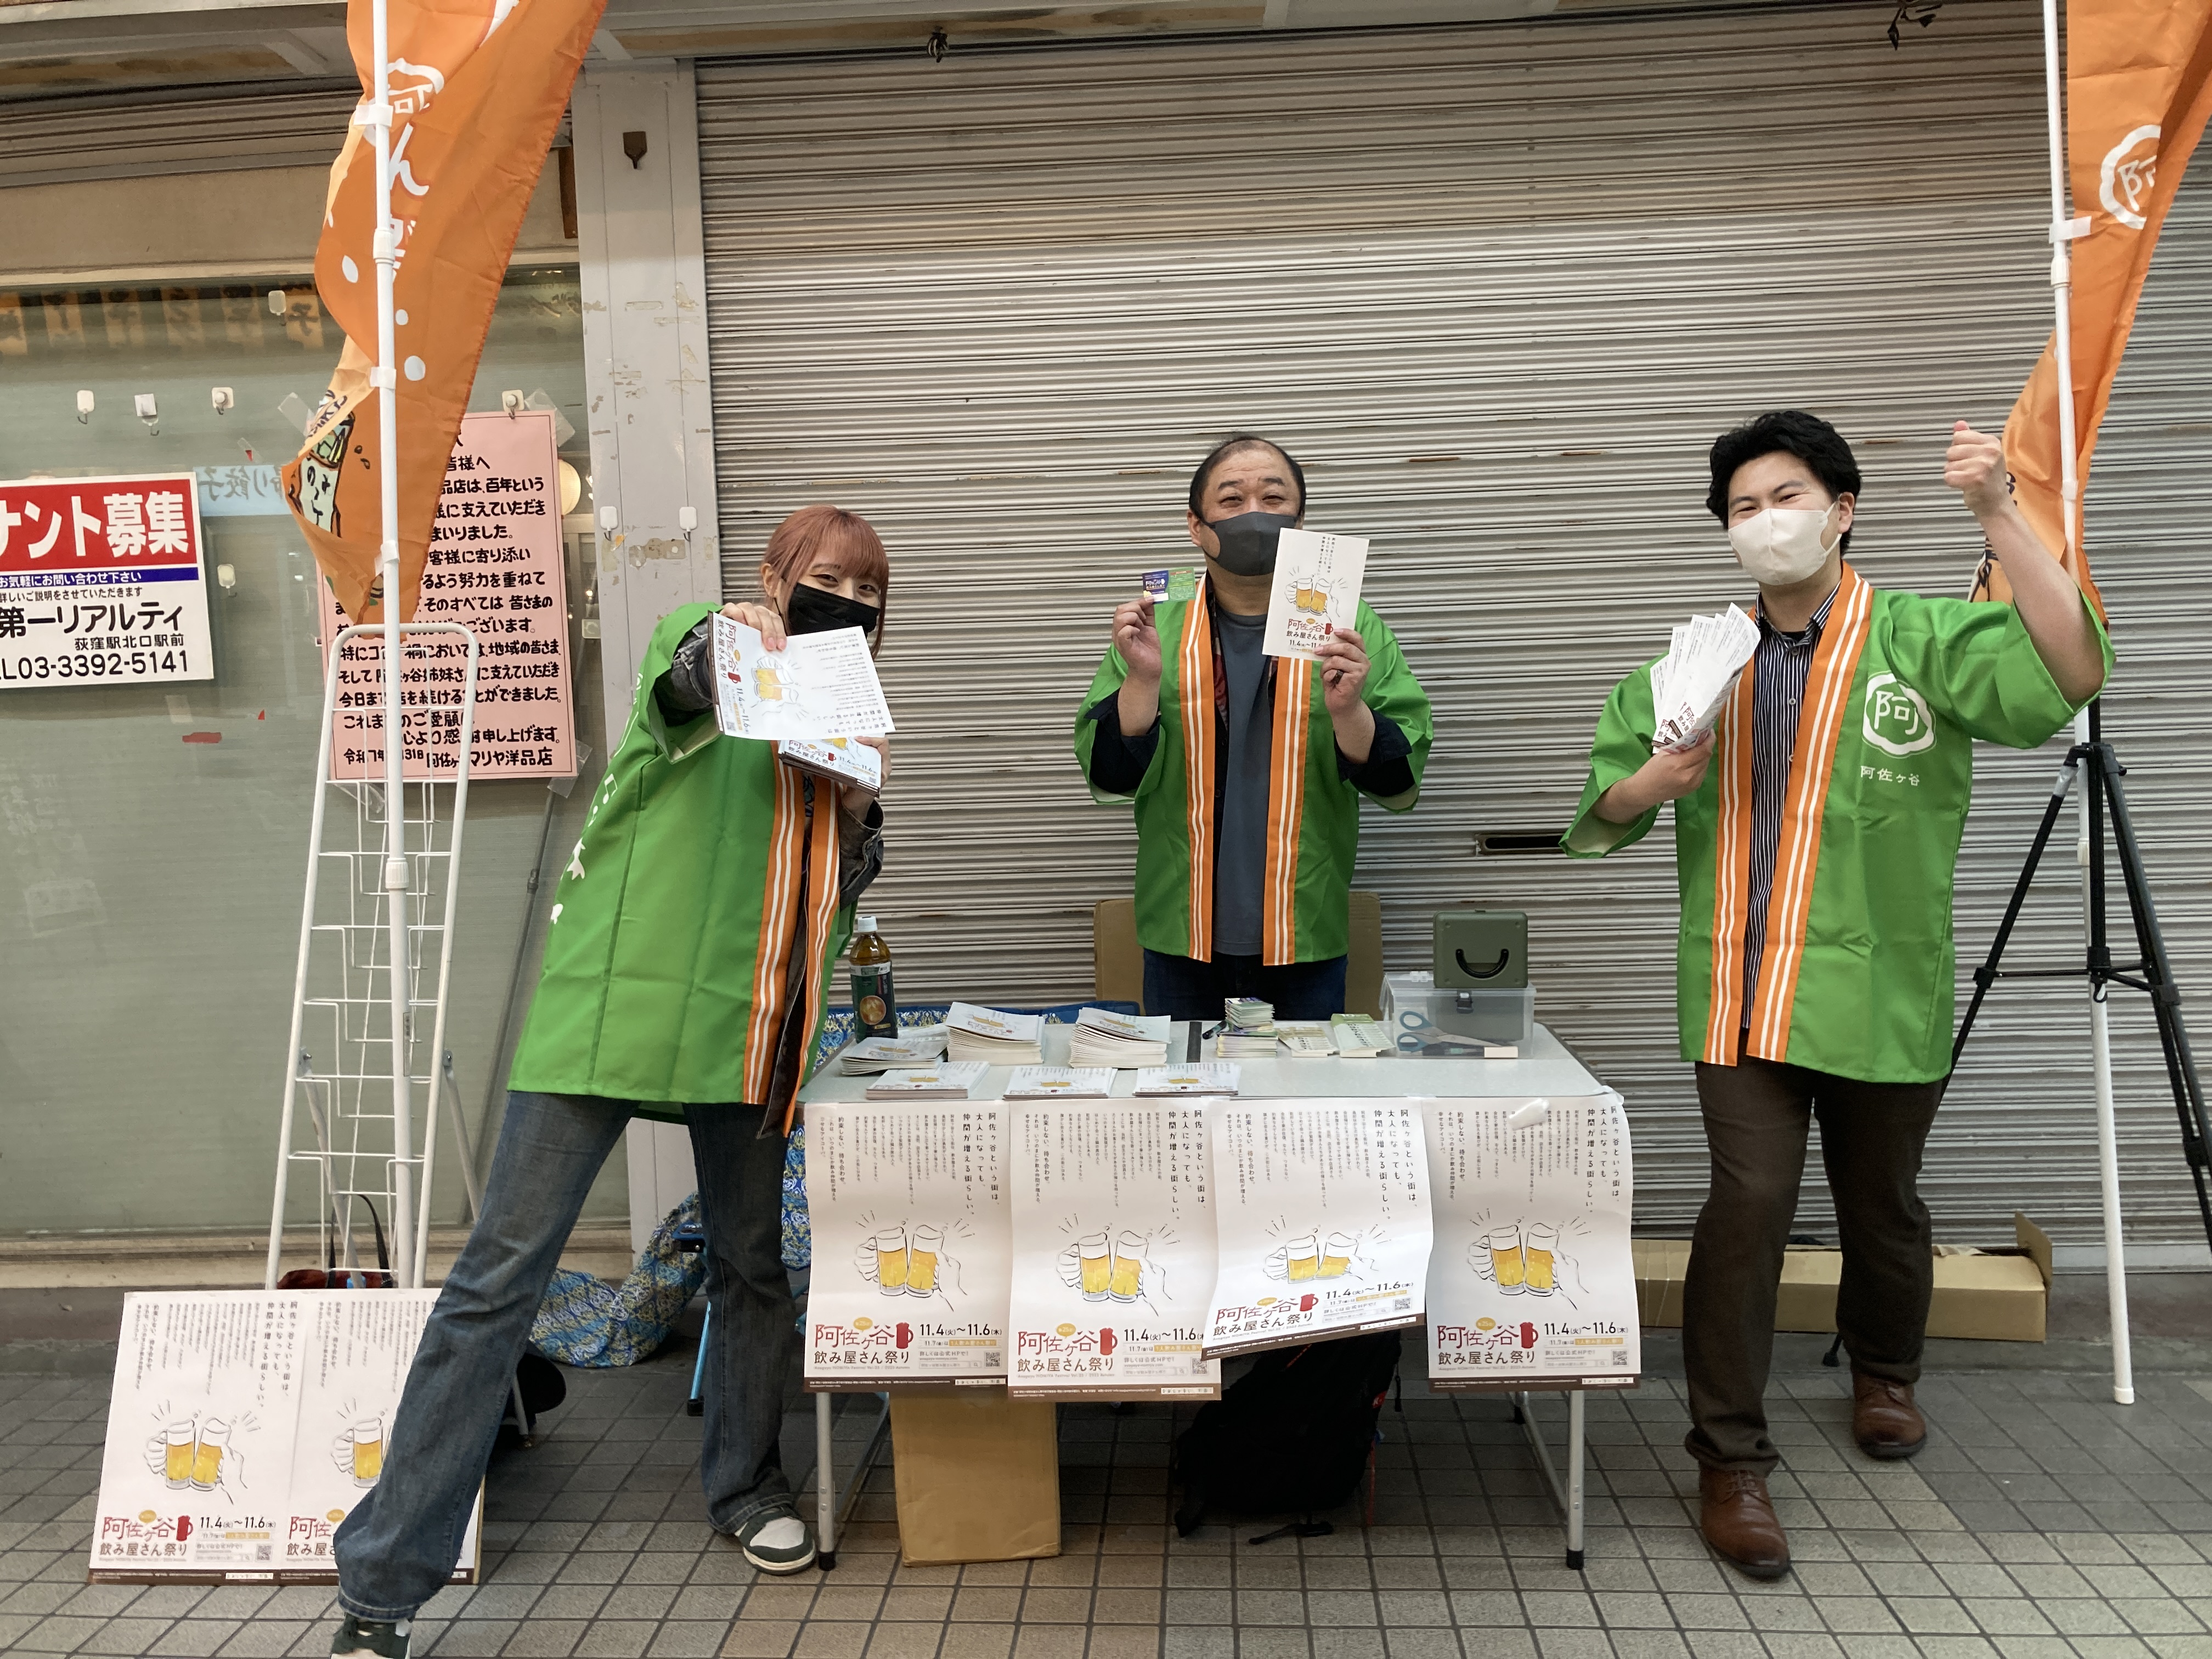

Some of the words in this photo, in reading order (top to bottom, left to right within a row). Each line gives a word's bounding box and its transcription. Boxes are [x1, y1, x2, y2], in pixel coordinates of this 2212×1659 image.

[429, 546, 531, 566] 客様に寄り添い
[0, 571, 142, 588] お気軽にお問い合わせ下さい
[422, 571, 546, 589] るよう努力を重ねて
[0, 601, 183, 639] 第一リアルティ
[1288, 618, 1324, 633] 阿佐ヶ谷
[75, 633, 184, 651] 荻窪駅北口駅前
[1286, 630, 1330, 641] 飲み屋さん祭り
[0, 650, 188, 680] L03-3392-5141
[1216, 1298, 1299, 1325] 阿佐ヶ谷
[1213, 1312, 1312, 1336] 飲み屋さん祭り
[815, 1324, 895, 1349] 阿佐ヶ谷
[1018, 1330, 1098, 1357] 阿佐ヶ谷
[1437, 1325, 1519, 1350] 阿佐ヶ谷
[814, 1351, 909, 1364] 飲み屋さん祭り
[1018, 1357, 1113, 1372] 飲み屋さん祭り
[1438, 1350, 1534, 1365] 飲み屋さん祭り
[102, 1516, 176, 1542] 阿佐ヶ谷
[289, 1516, 335, 1540] 阿佐
[100, 1543, 187, 1556] 飲み屋さん祭り
